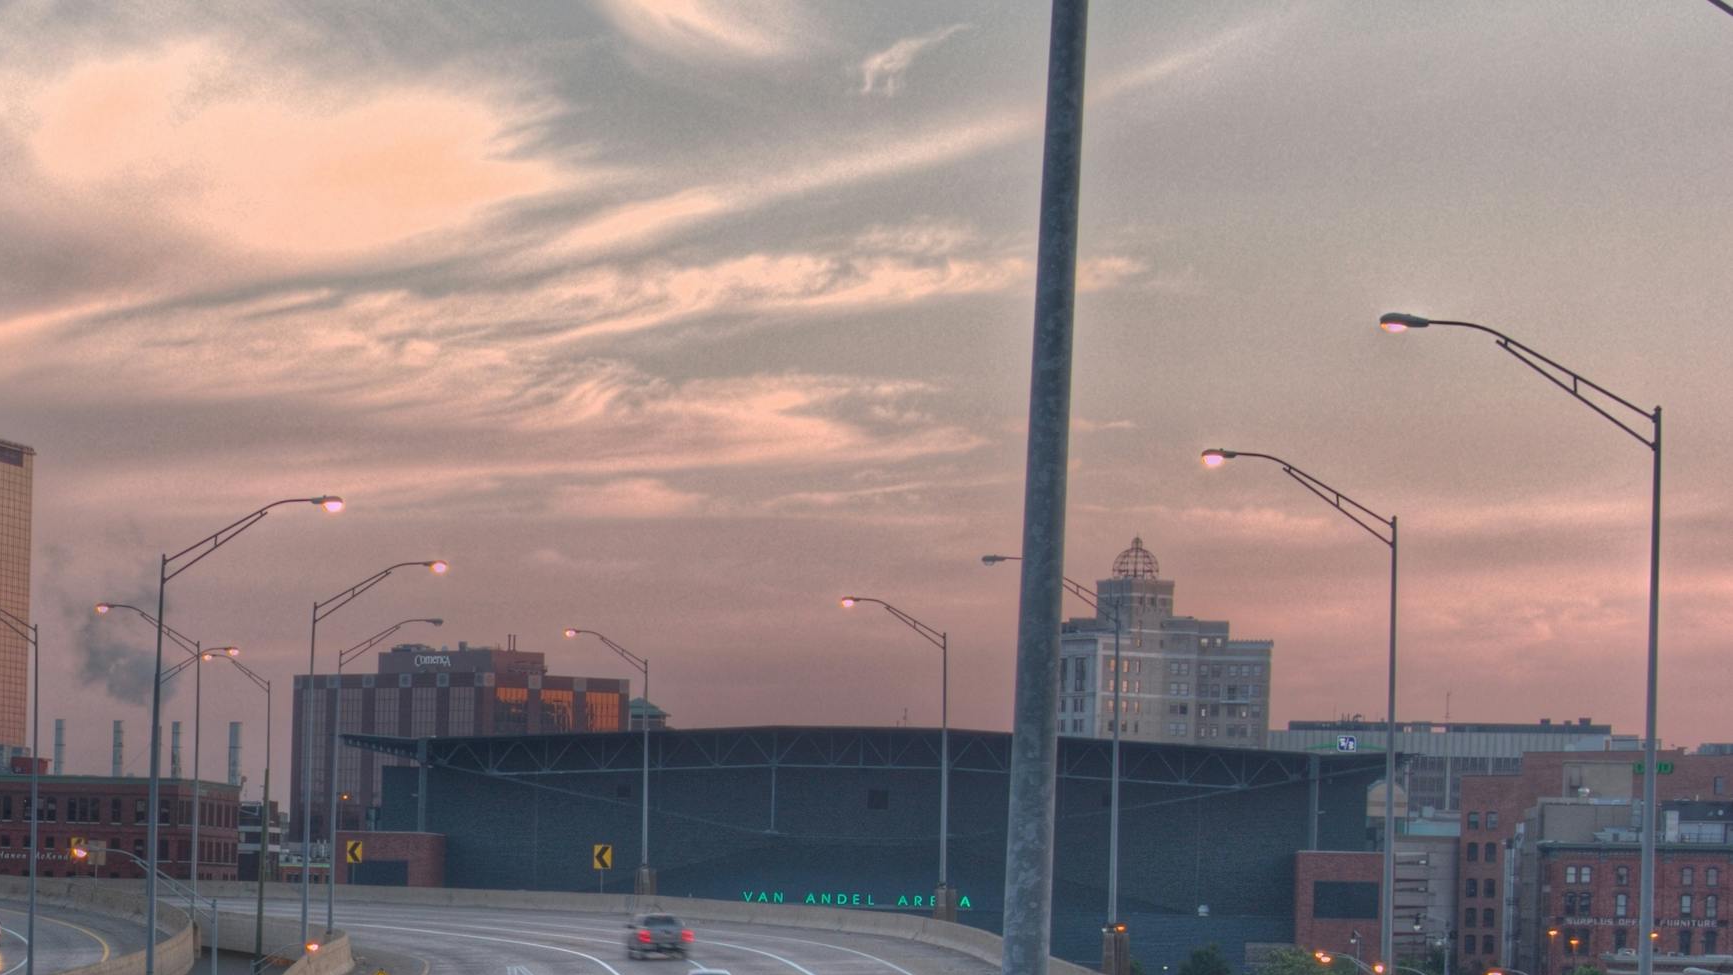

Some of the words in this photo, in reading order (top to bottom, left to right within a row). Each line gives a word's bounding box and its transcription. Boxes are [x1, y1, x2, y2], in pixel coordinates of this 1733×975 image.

[743, 891, 785, 903] VAN
[805, 893, 875, 906] ANDEL
[897, 895, 971, 908] AREA
[1567, 918, 1613, 926] SURPLUS
[1659, 919, 1717, 928] FURNITURE
